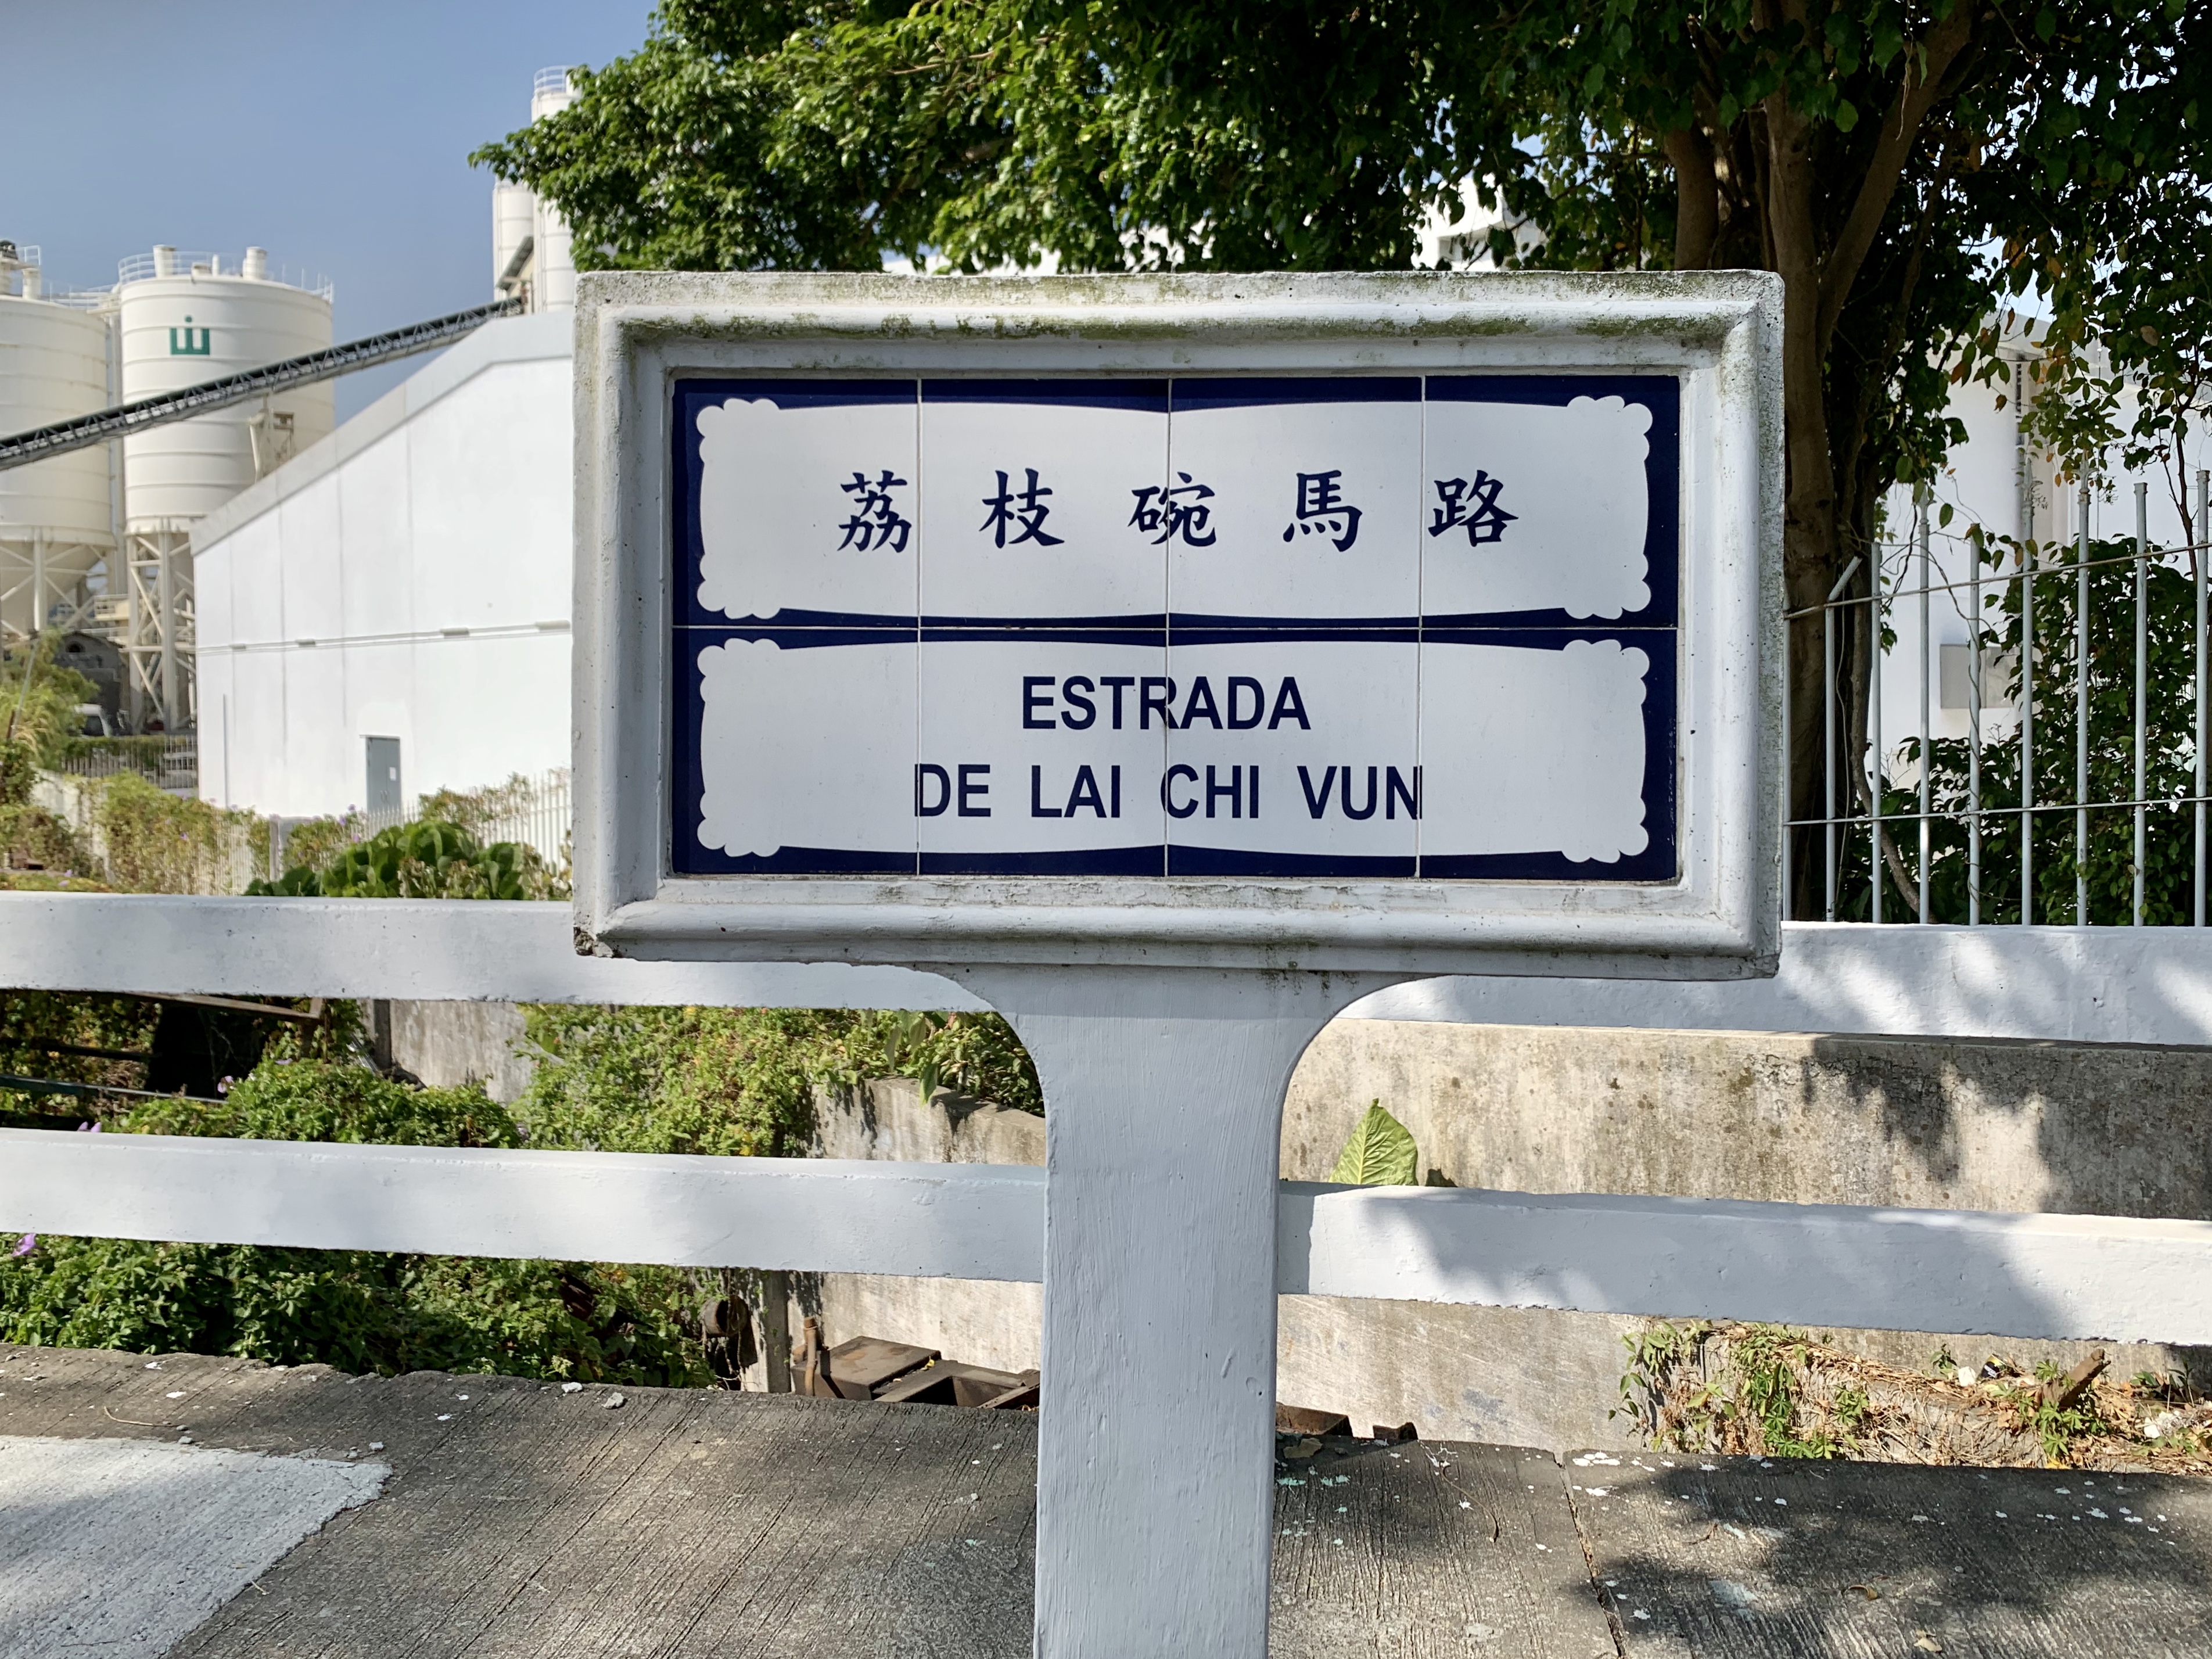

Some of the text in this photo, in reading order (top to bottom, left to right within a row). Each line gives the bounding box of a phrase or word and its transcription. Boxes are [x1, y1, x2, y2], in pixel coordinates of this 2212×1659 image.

[837, 468, 1519, 553] 荔枝碗馬路
[1022, 676, 1311, 730] ESTRADA
[915, 763, 1423, 820] DE LAI CHI VUN
